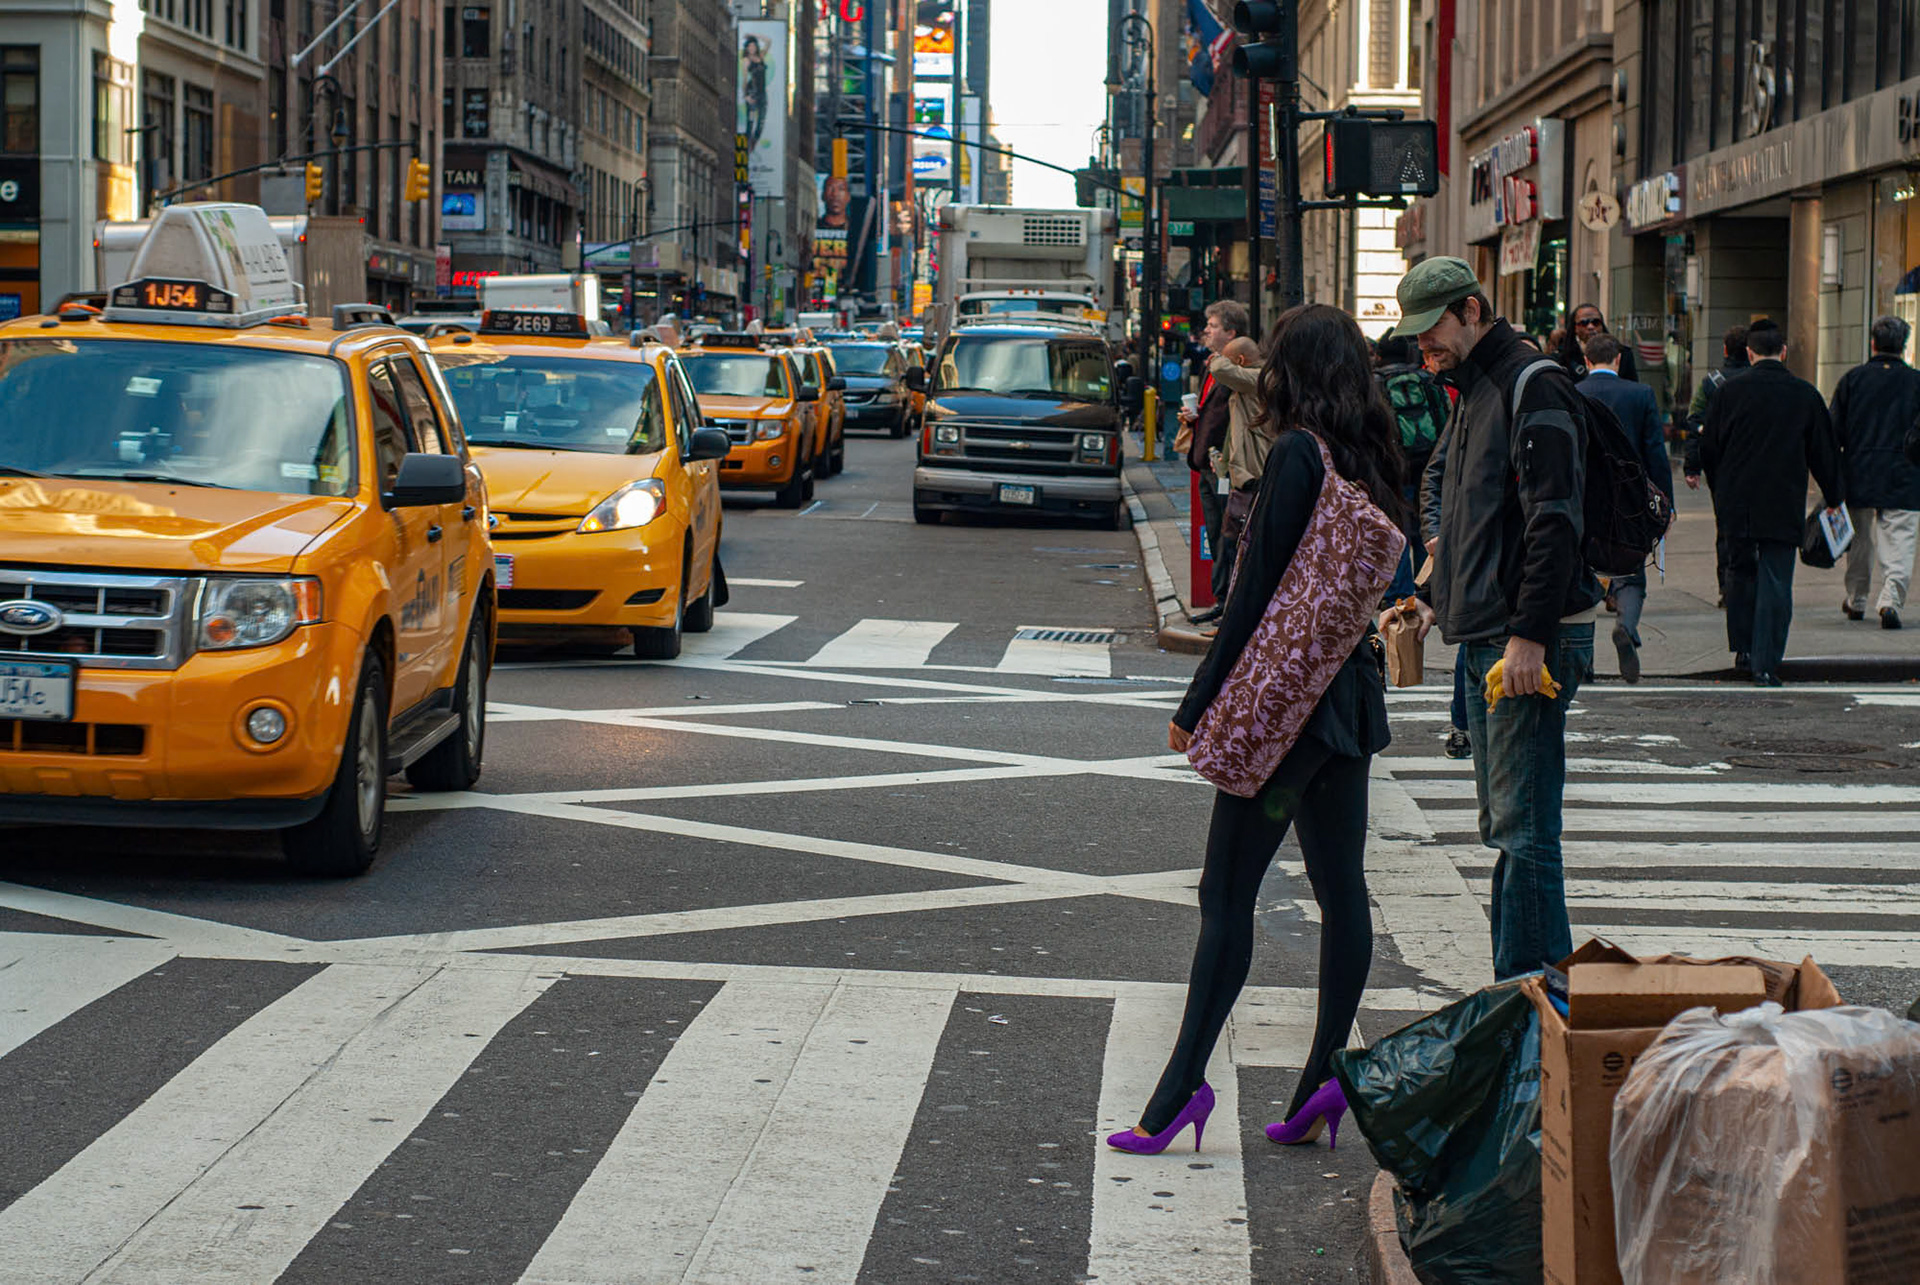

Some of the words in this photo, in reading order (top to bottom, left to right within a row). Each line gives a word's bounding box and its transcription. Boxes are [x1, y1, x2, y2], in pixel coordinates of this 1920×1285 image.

[445, 170, 478, 185] TAN
[145, 283, 197, 308] 1J54
[513, 316, 551, 332] 2E69
